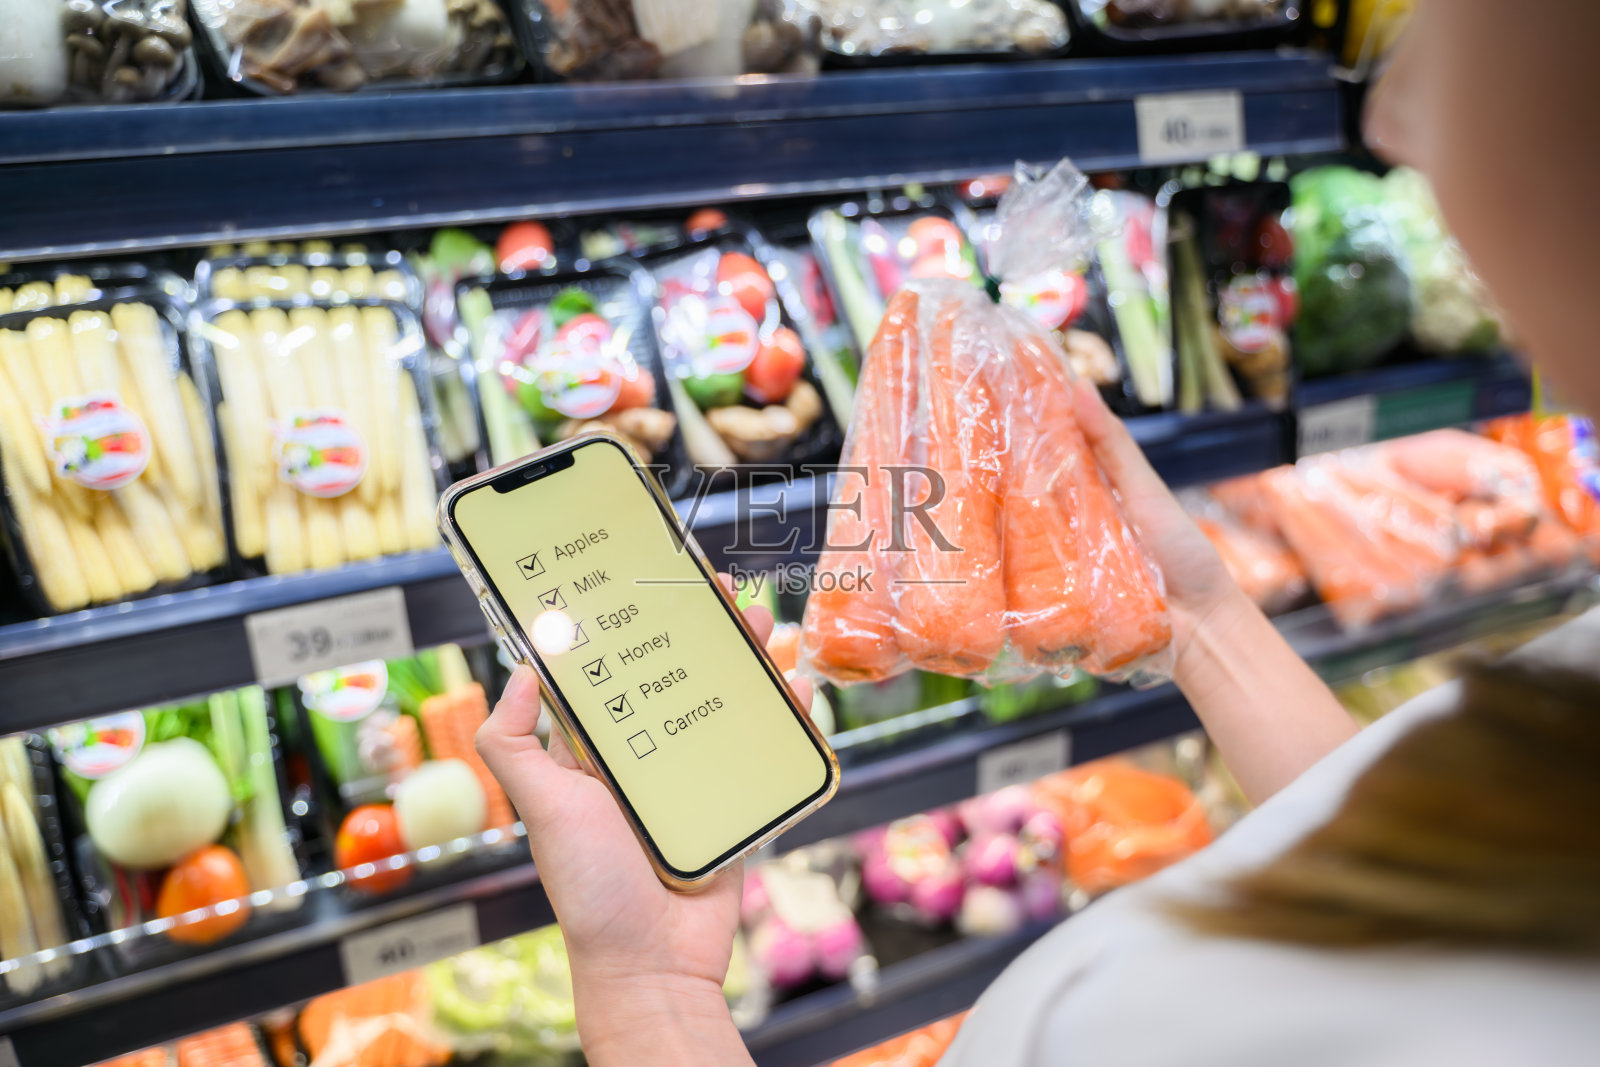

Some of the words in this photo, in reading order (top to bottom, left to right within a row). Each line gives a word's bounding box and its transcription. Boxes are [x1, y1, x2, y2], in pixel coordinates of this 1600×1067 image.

[554, 528, 609, 560] Apples
[573, 569, 611, 594] Milk
[596, 603, 639, 631] Eggs
[286, 625, 333, 664] 39
[618, 632, 671, 666] Honey
[639, 668, 688, 700] Pasta
[663, 697, 724, 736] Carrots
